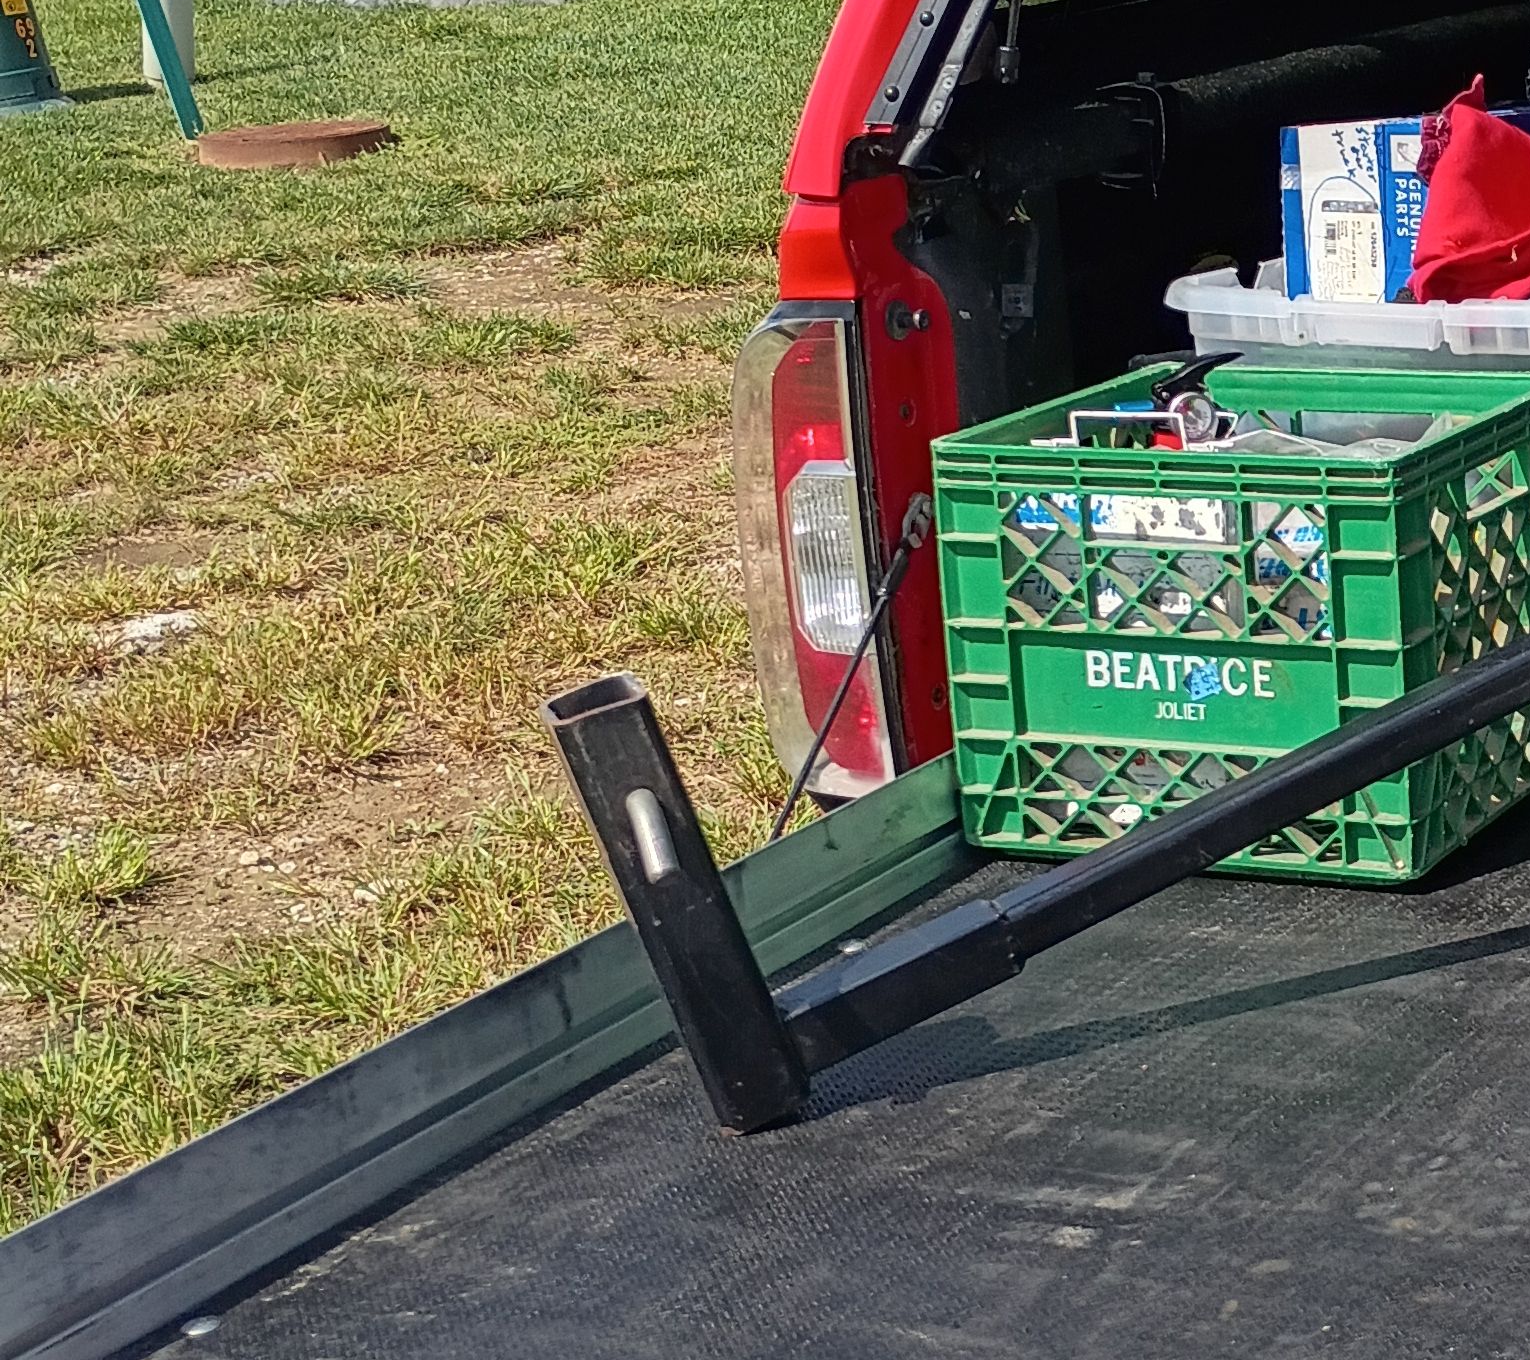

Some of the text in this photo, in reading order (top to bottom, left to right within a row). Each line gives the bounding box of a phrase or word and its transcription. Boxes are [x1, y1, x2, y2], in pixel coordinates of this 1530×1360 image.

[1394, 177, 1409, 237] PARTS
[1408, 178, 1422, 264] GENUI
[1085, 649, 1276, 699] BEATCE
[1154, 701, 1207, 721] JOLIET
